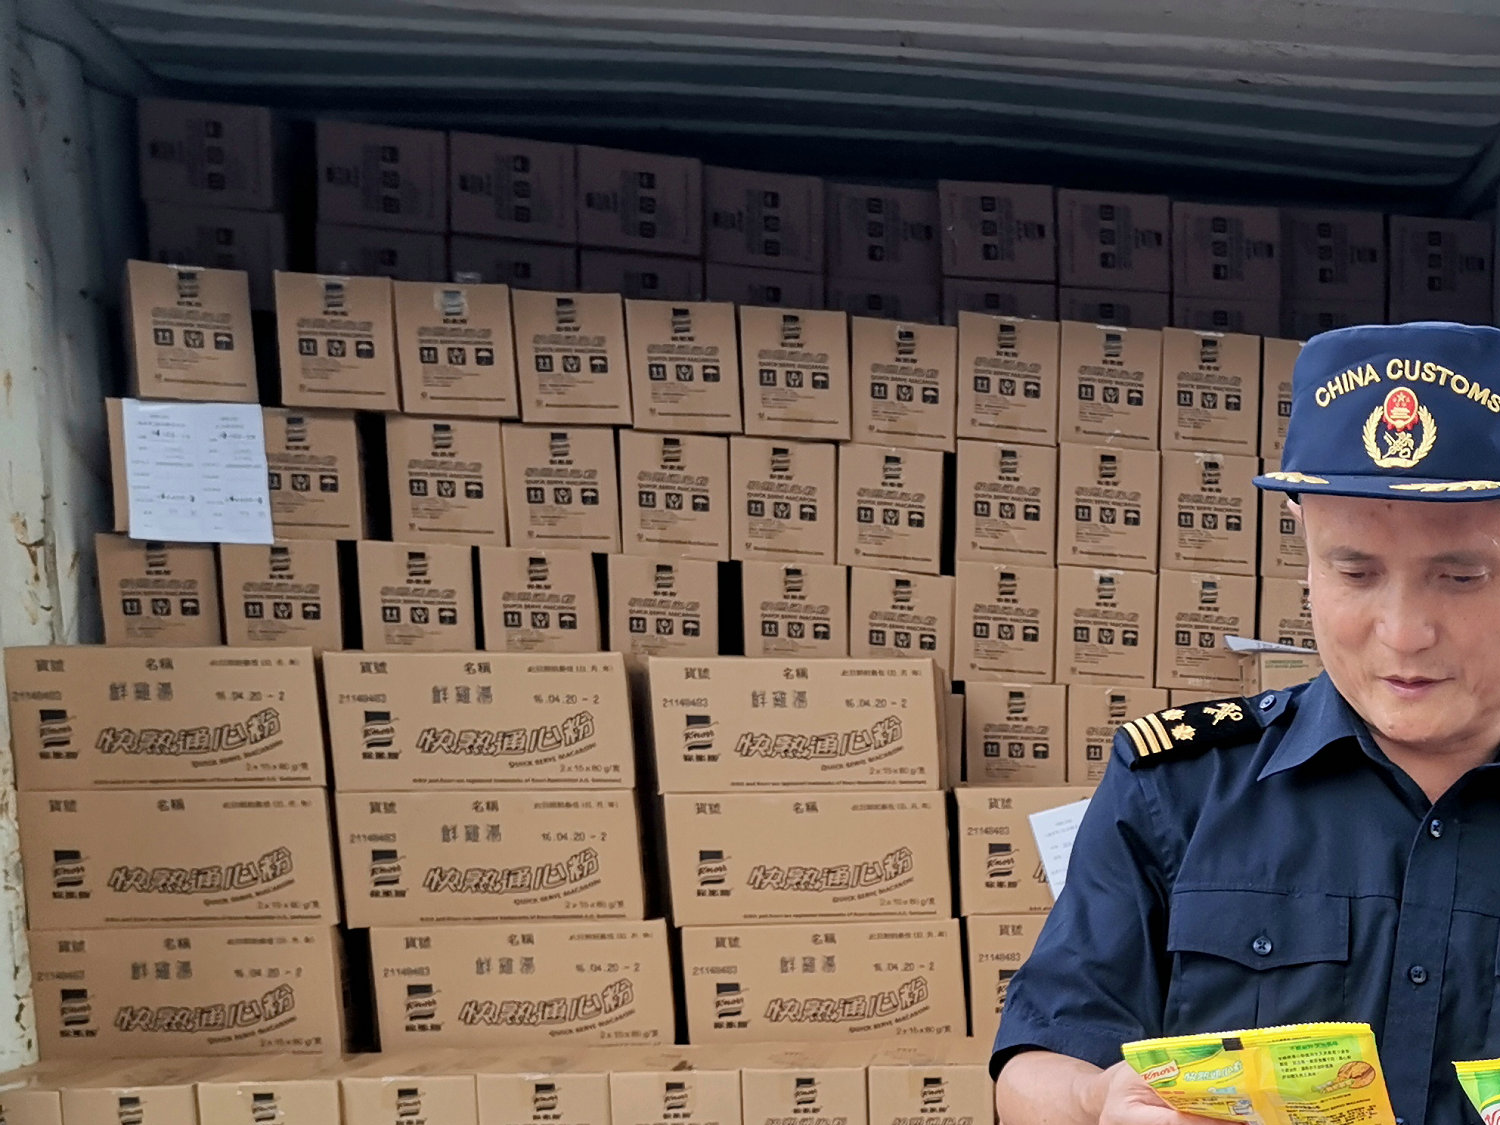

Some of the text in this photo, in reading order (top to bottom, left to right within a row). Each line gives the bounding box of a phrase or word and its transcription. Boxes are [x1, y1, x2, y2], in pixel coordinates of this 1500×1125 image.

[1315, 363, 1380, 408] CHINA
[416, 711, 593, 756] 快熟通心粉
[735, 715, 902, 760] 快熟通心粉
[423, 848, 598, 893] 快熟通心粉
[748, 847, 912, 891] 快熟通心粉
[459, 978, 633, 1025] 快熟通心粉
[764, 976, 928, 1023] 快熟通心粉
[1143, 1066, 1176, 1081] Knorr
